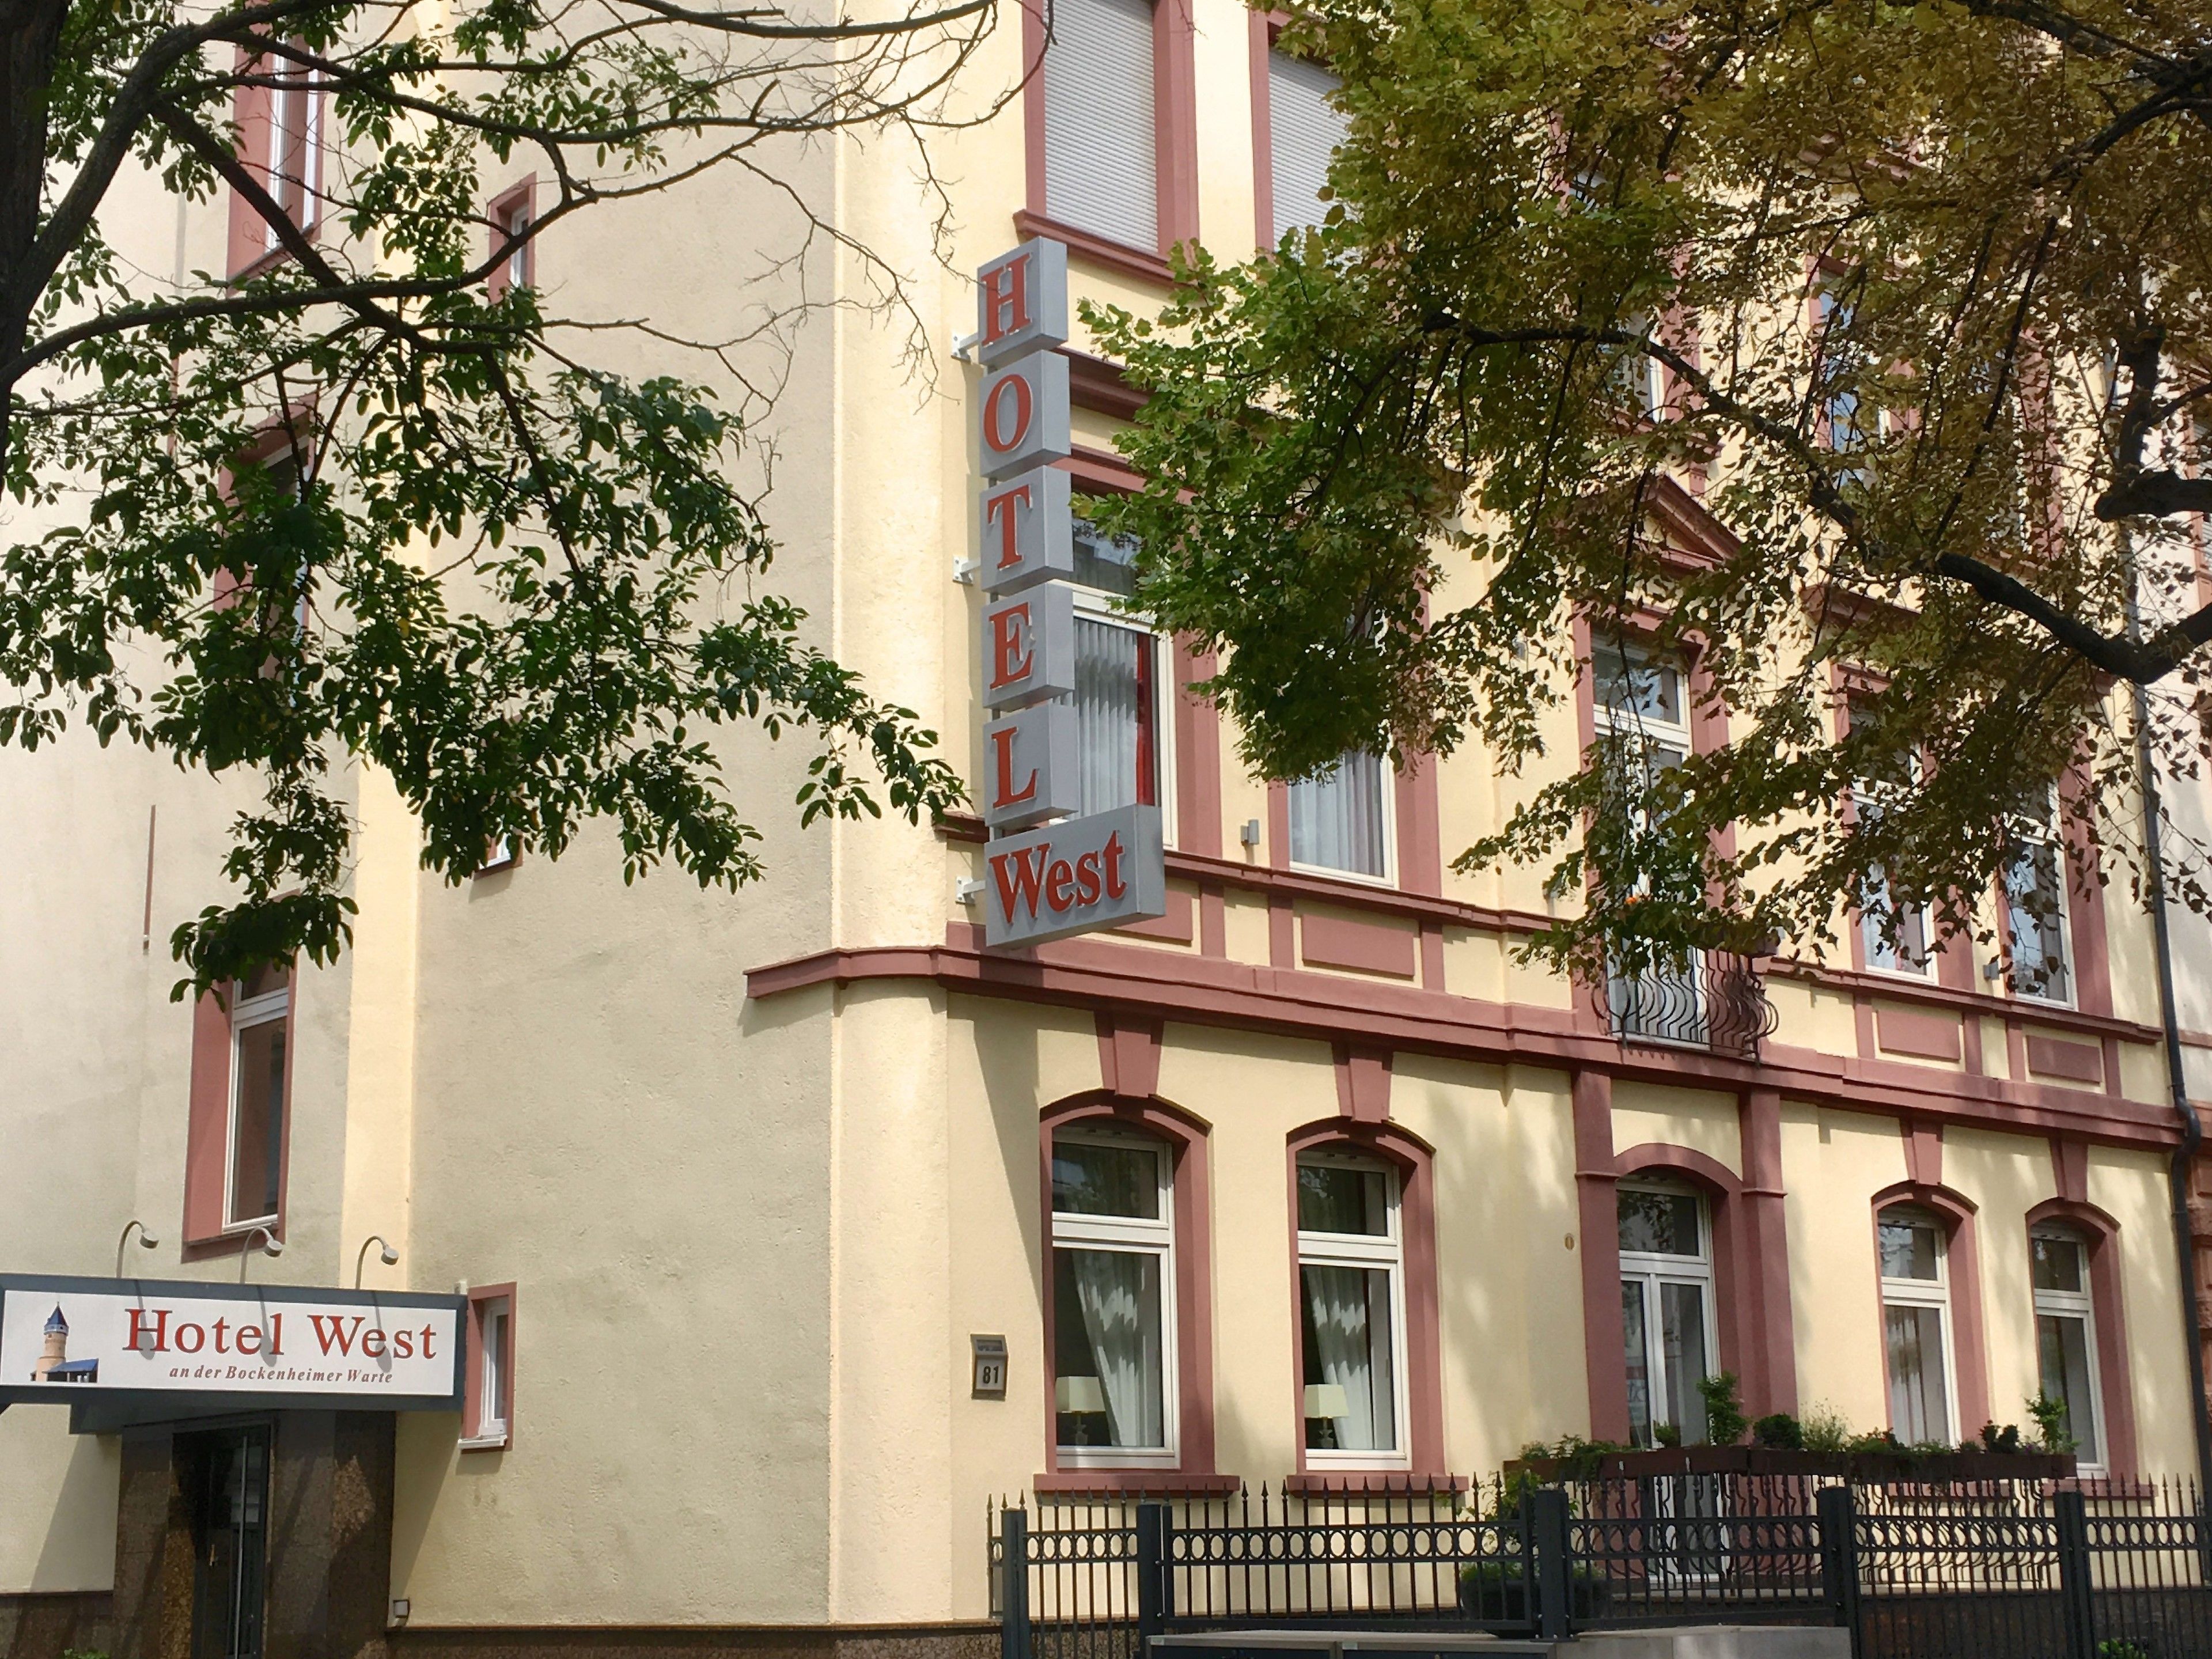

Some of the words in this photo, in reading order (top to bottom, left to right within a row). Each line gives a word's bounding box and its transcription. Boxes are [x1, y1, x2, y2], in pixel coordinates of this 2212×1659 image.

[980, 251, 1038, 809] HOTEL
[988, 830, 1128, 925] West
[122, 1308, 285, 1356] Hotel
[307, 1314, 437, 1360] West
[169, 1368, 190, 1378] an
[194, 1365, 222, 1378] der
[225, 1366, 343, 1382] Bockenheimer
[347, 1369, 393, 1383] Warte
[983, 1366, 999, 1384] 81
